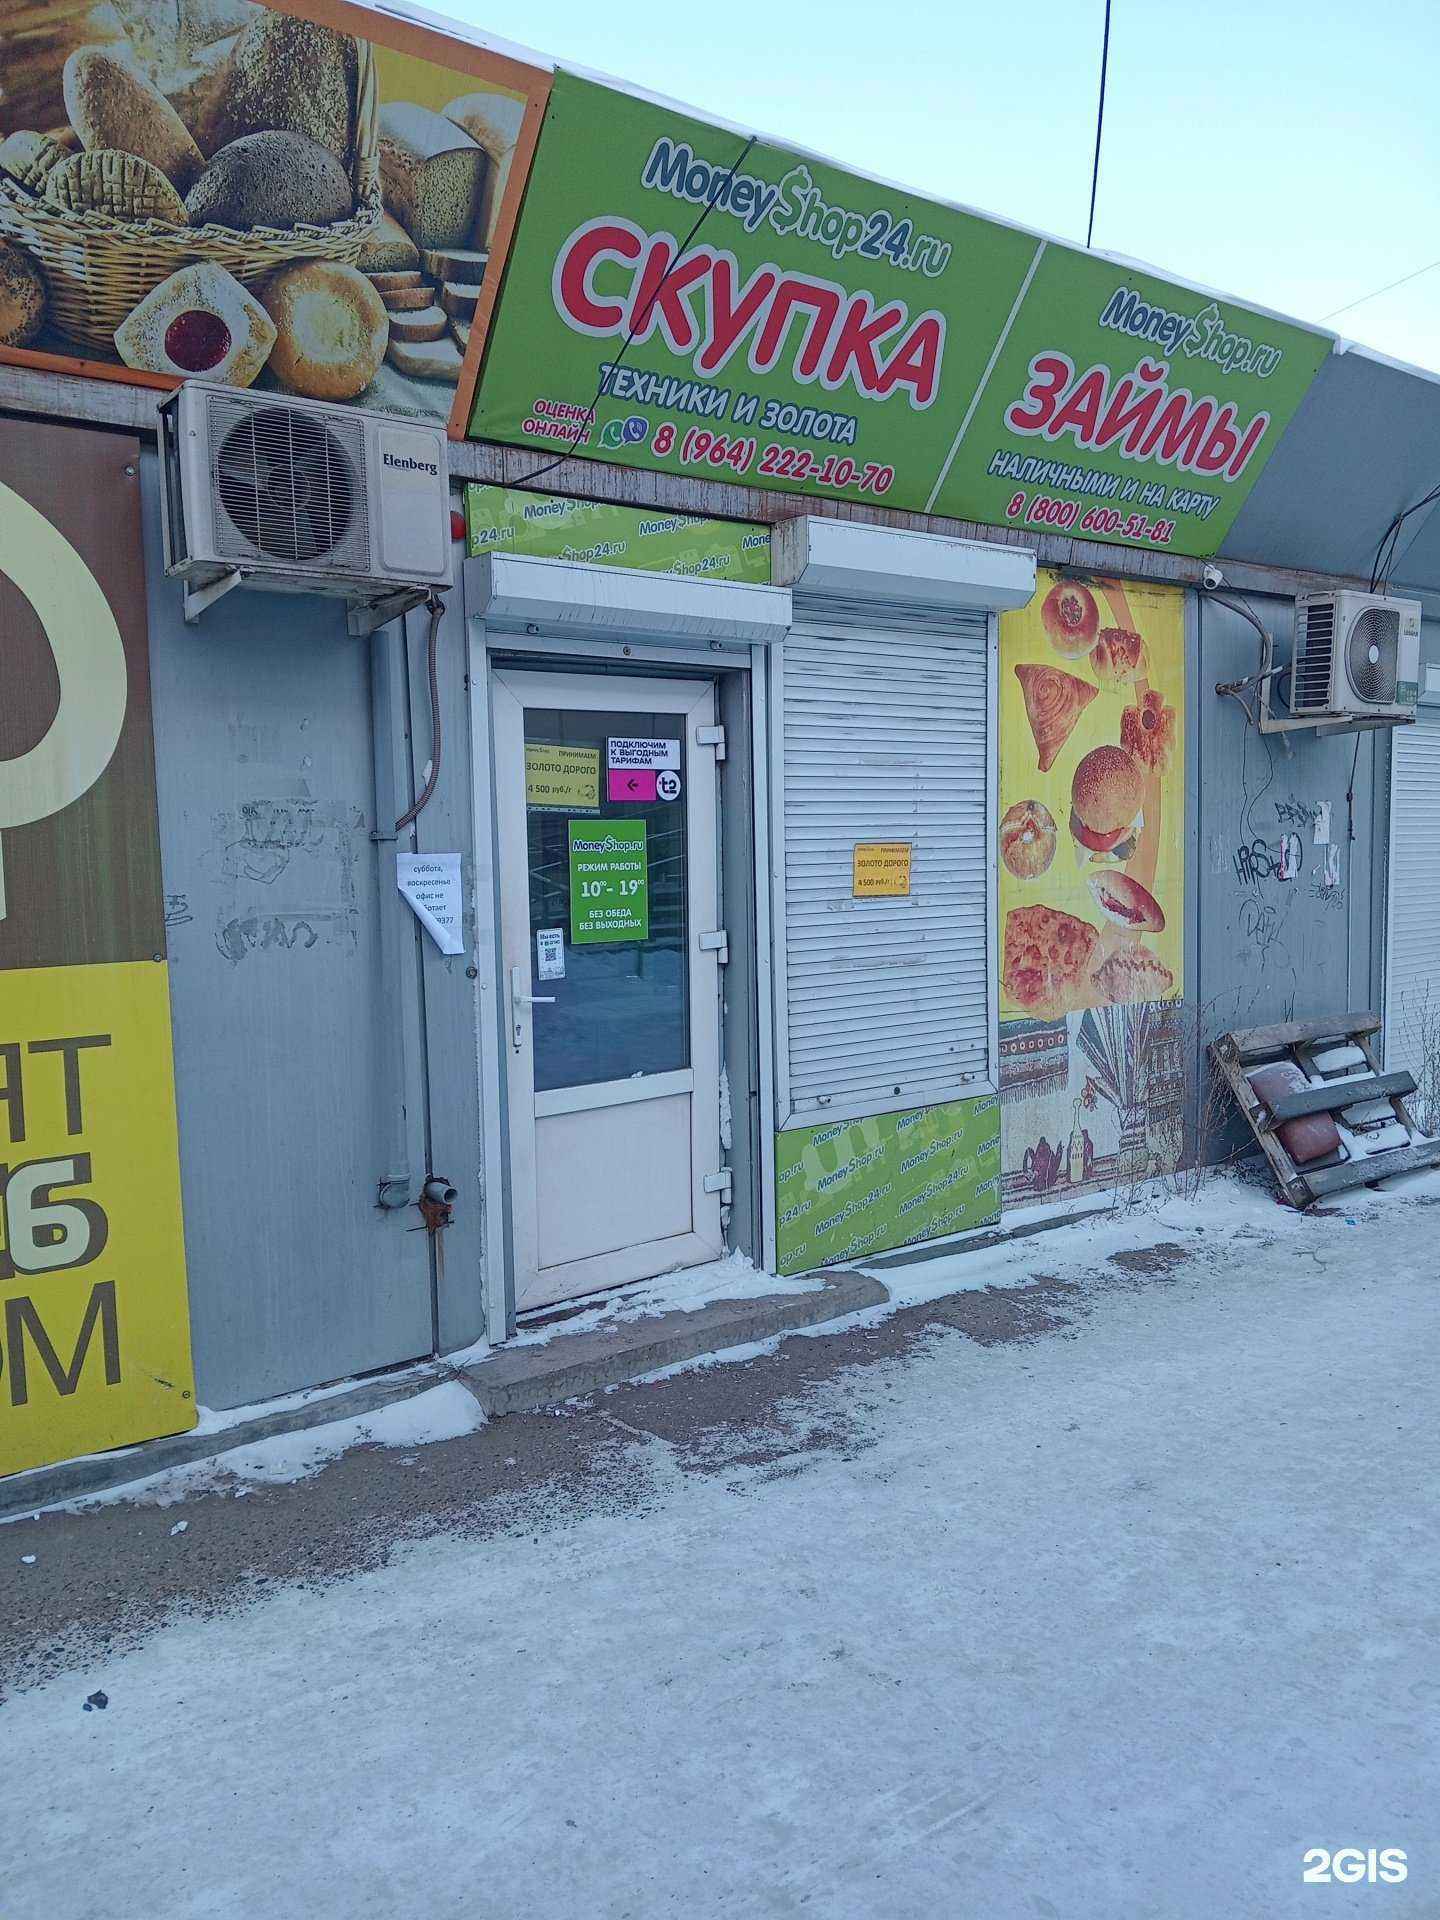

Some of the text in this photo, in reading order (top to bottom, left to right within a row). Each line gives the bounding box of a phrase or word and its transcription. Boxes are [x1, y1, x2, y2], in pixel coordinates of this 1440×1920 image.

[556, 219, 944, 407] СКУПКА
[534, 400, 596, 425] ОЦЕНКА
[600, 364, 856, 445] ТЕХНИКИ И ЗОЛОТА
[1006, 352, 1270, 481] ЗАЙМЫ
[522, 418, 591, 444] ОНЛАЙН
[383, 453, 438, 476] Elenberg
[651, 422, 894, 494] 8 (964) 222-10-70
[987, 450, 1221, 520] НАЛИЧНЫМИ И НА КАРТУ
[1006, 492, 1176, 544] 8 (800) 600-51-81
[610, 740, 667, 749] ПОДКЛЮЧИМ
[610, 748, 668, 757] К ВЫГОДНЫМ
[526, 762, 596, 775] ЗОЛОТО ДОРОГО
[610, 756, 652, 765] ТАРИФАМ
[527, 784, 533, 792] 4
[535, 784, 550, 793] 500
[413, 864, 444, 874] суббота,
[577, 862, 642, 872] РЕЖИМ РАБОТЫ
[415, 892, 433, 902] офис
[589, 908, 632, 918] БЕЗ ОБЕДА
[579, 919, 642, 930] БЕЗ ВЫХОДНЫХ
[0, 1280, 122, 1407] М
